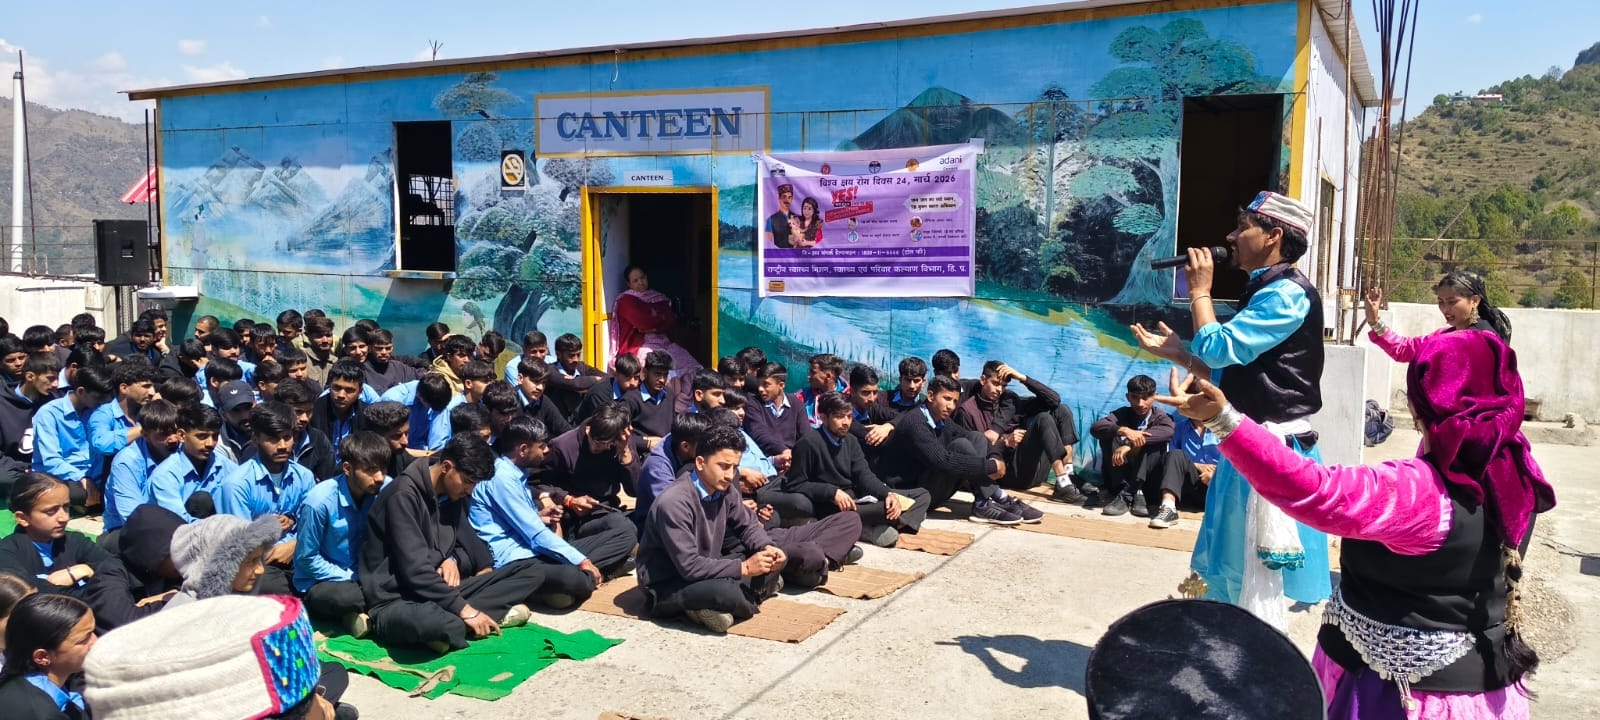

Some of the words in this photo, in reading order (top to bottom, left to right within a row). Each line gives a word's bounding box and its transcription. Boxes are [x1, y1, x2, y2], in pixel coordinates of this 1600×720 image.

[556, 106, 742, 140] CANTEEN
[940, 155, 963, 165] adani
[820, 177, 837, 187] विश्व
[840, 177, 854, 187] क्षय
[857, 176, 869, 186] रोग
[873, 175, 893, 185] दिवस
[897, 177, 911, 186] 24,
[913, 172, 931, 184] मार्च
[934, 174, 956, 183] 2026
[831, 186, 859, 205] YES!
[767, 264, 786, 275] राष्ट्रीय
[858, 264, 868, 273] एवं
[870, 264, 891, 273] परिवार
[893, 265, 918, 273] कल्याण
[921, 263, 945, 274] विभाग,
